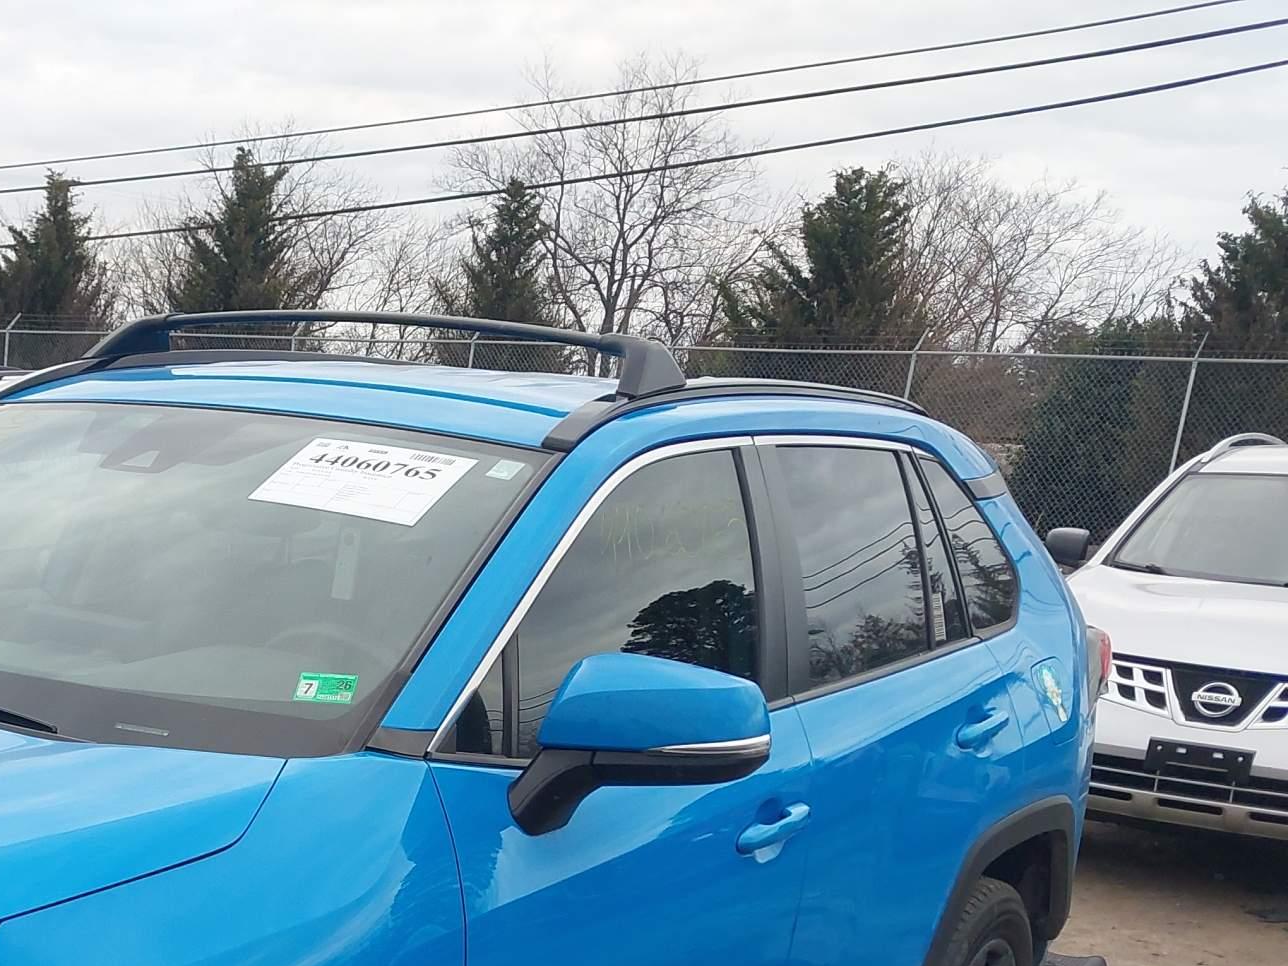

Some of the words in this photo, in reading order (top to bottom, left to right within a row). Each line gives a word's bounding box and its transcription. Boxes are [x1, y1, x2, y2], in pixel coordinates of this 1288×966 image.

[309, 453, 443, 480] 44060765
[304, 682, 314, 695] 7
[337, 680, 352, 691] 26
[1197, 694, 1236, 704] NISSAN
